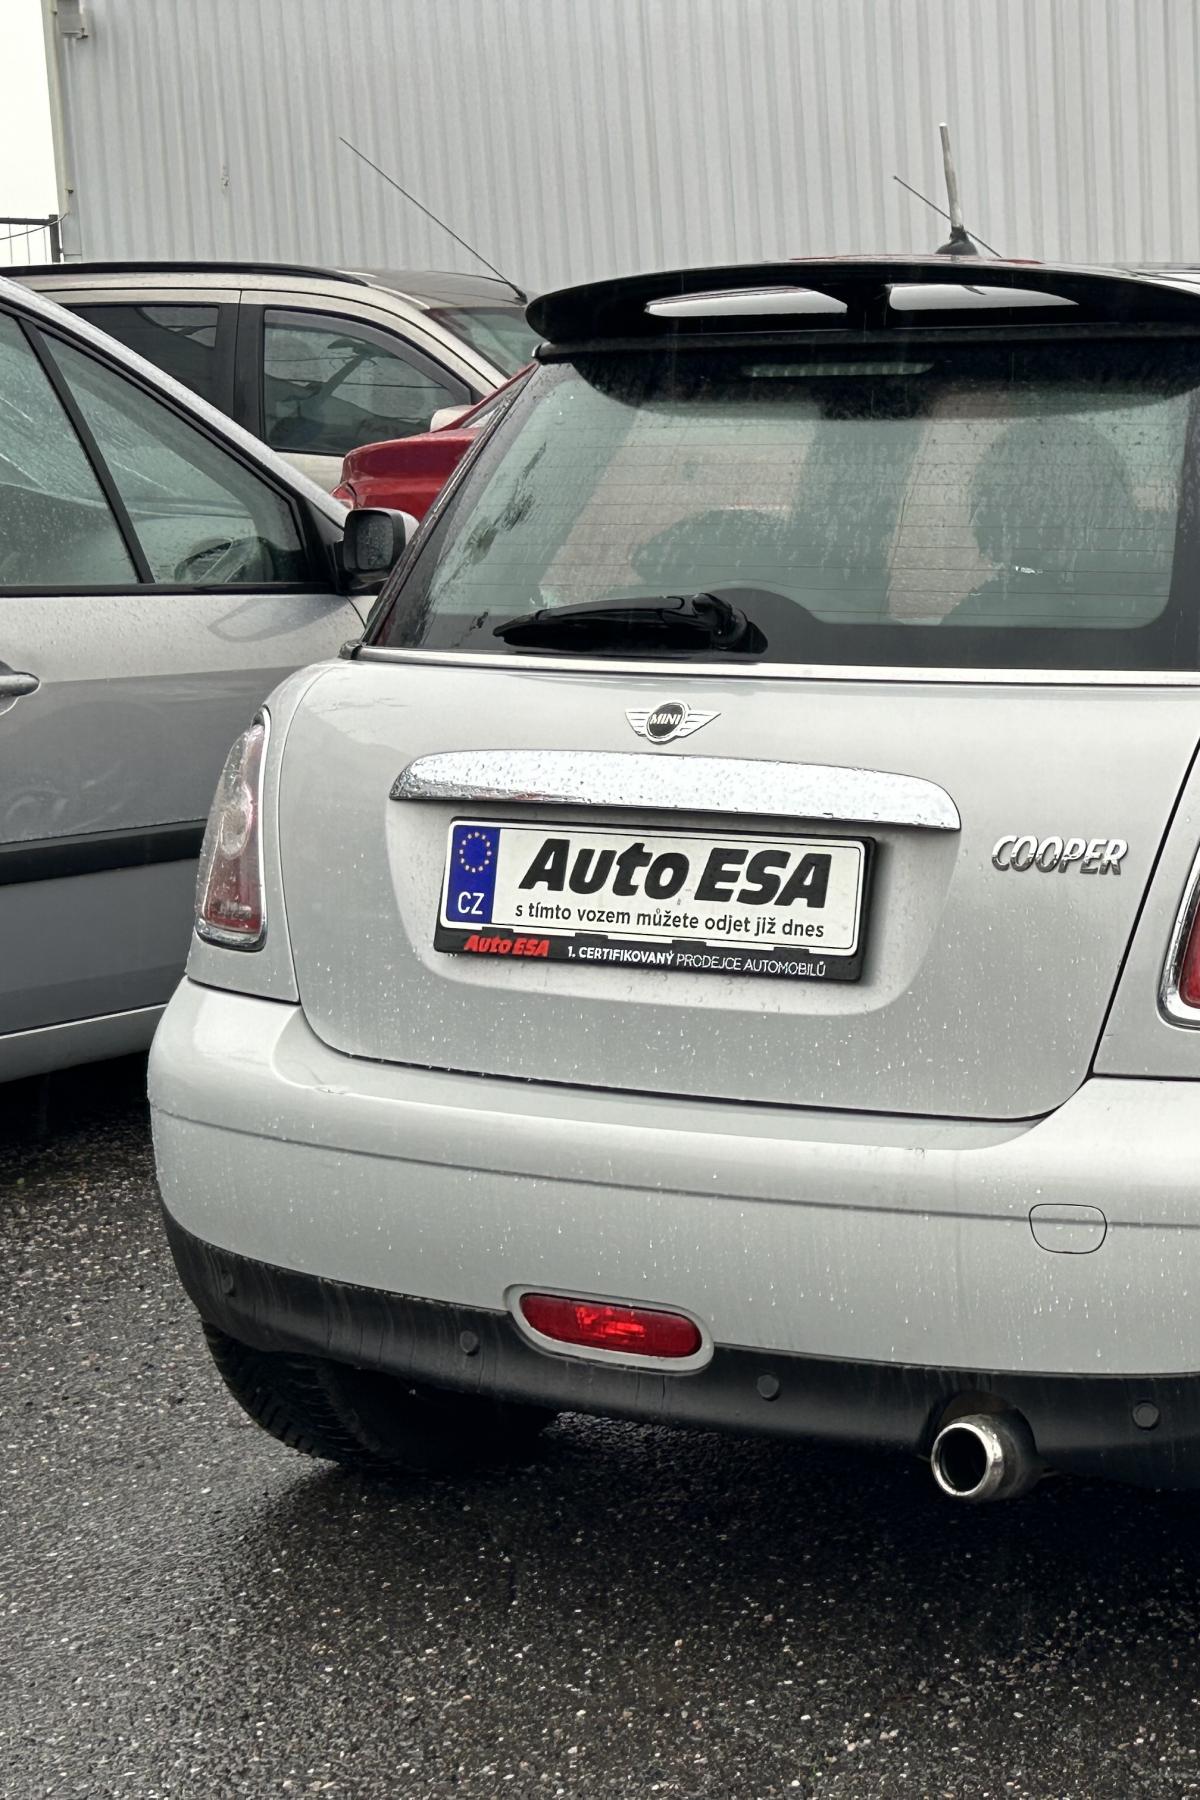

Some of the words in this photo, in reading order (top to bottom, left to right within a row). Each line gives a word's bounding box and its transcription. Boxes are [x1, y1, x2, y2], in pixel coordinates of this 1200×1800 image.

[650, 713, 682, 725] MINI
[991, 835, 1129, 875] COOPER
[518, 838, 690, 900] Auto
[693, 847, 832, 909] ESA
[457, 891, 485, 915] CZ
[515, 904, 523, 917] s
[528, 902, 571, 920] tímto
[577, 908, 630, 925] vozem
[636, 908, 699, 929] můžete
[704, 915, 751, 935] odjet
[754, 917, 776, 936] již
[782, 919, 824, 938] dnes
[464, 935, 512, 955] Auto
[512, 937, 550, 957] ESA
[567, 946, 576, 958] 1.
[578, 947, 675, 965] CERTIFIKOVANÝ
[676, 953, 741, 971] PRODEJCE
[743, 957, 827, 977] AUTOMOBILŮ
